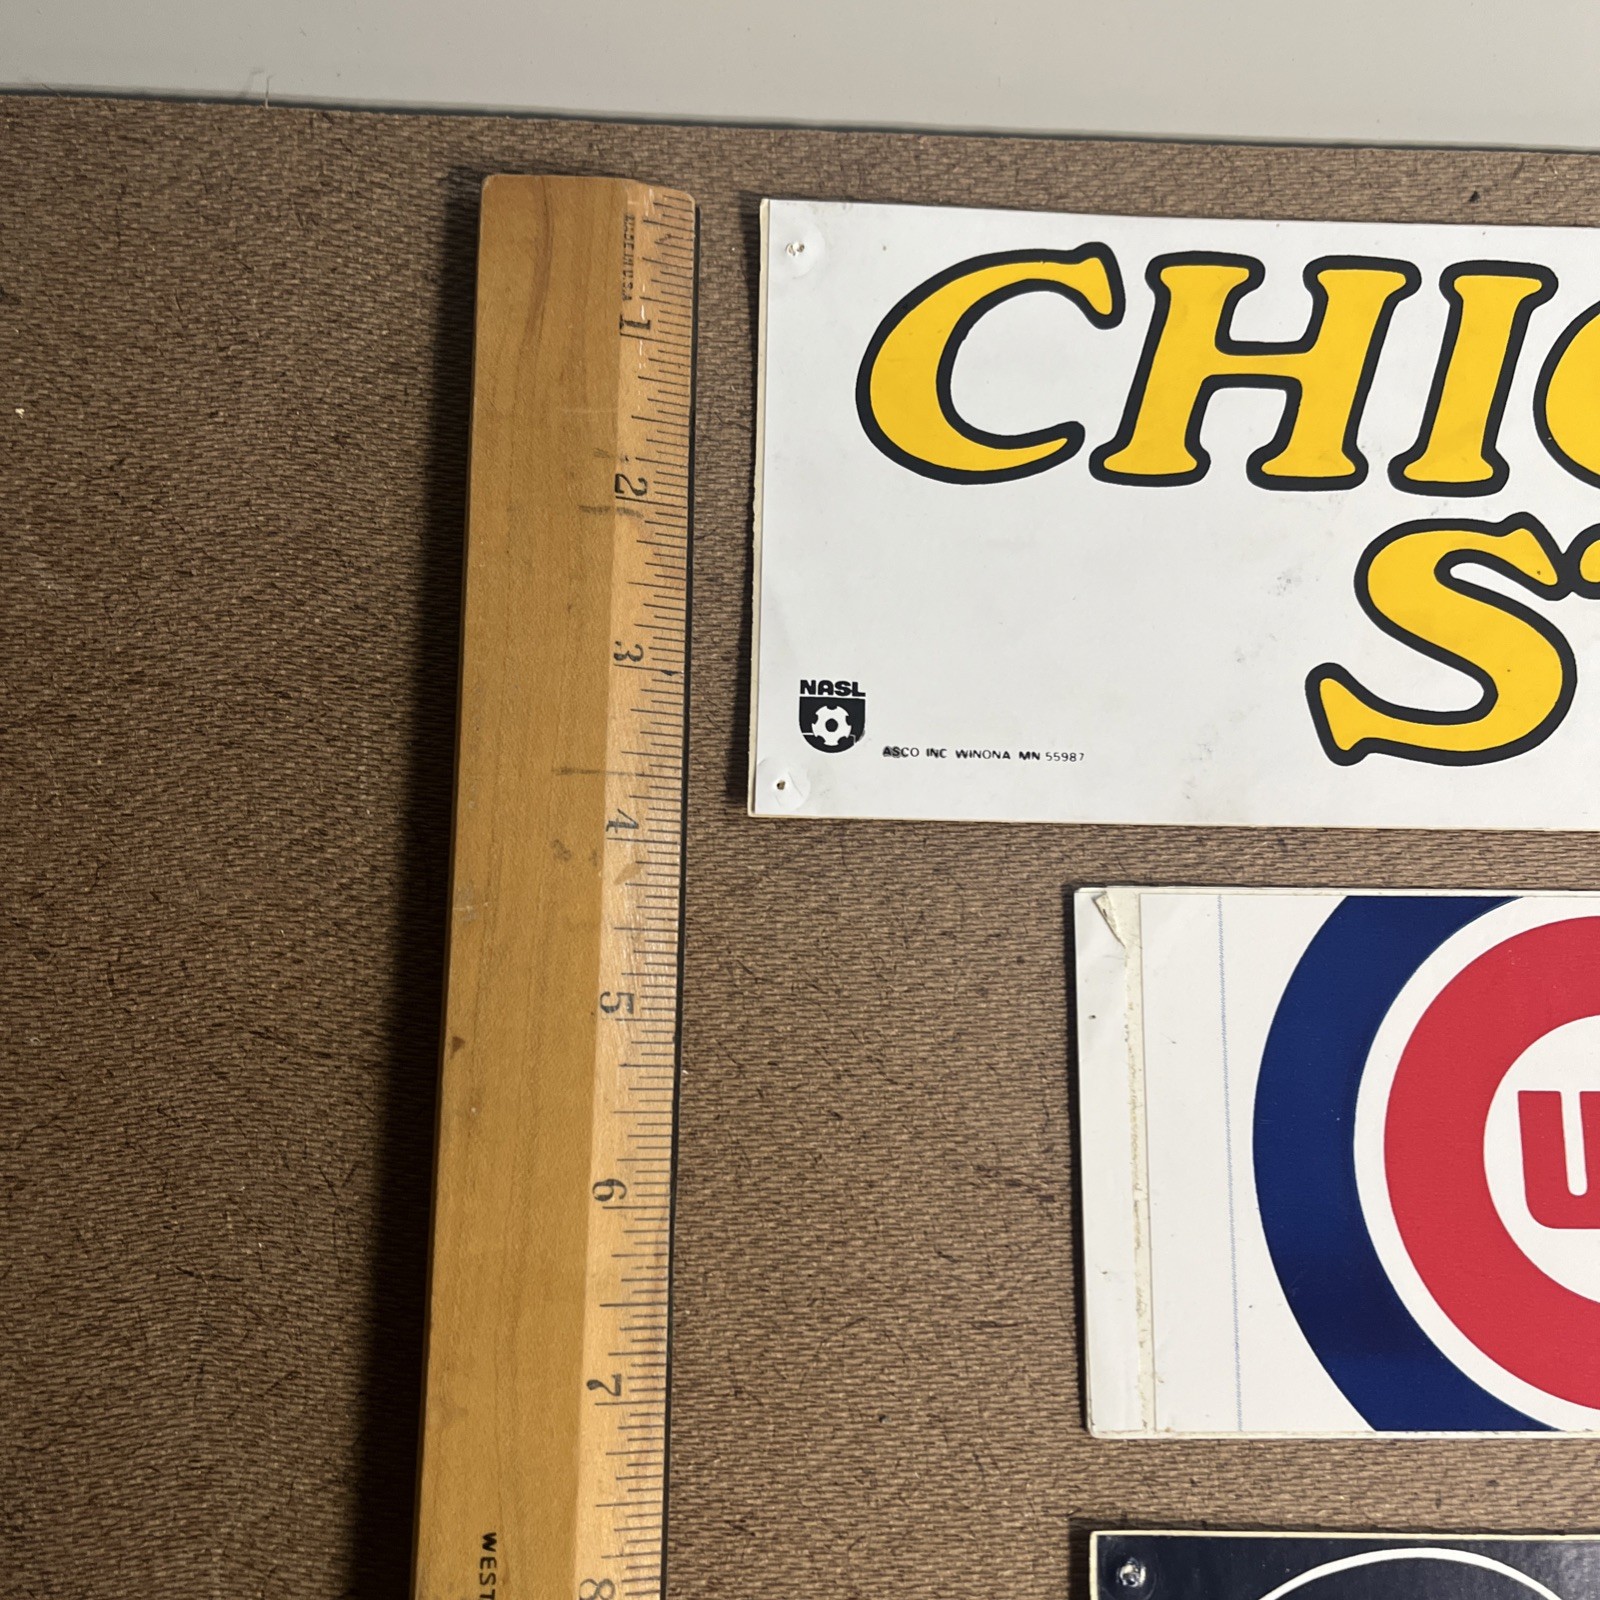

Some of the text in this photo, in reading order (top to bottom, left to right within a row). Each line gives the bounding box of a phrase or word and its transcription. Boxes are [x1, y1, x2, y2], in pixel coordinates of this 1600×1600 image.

[619, 314, 651, 332] 1
[614, 473, 648, 497] 2
[613, 640, 644, 663] 3
[800, 679, 866, 697] NASL
[882, 745, 1086, 763] ASCO INC WINONA MN 55987
[605, 808, 639, 833] 4
[599, 990, 635, 1014] 5
[591, 1177, 627, 1202] 6
[586, 1373, 622, 1397] 7
[578, 1577, 617, 1600] 8
